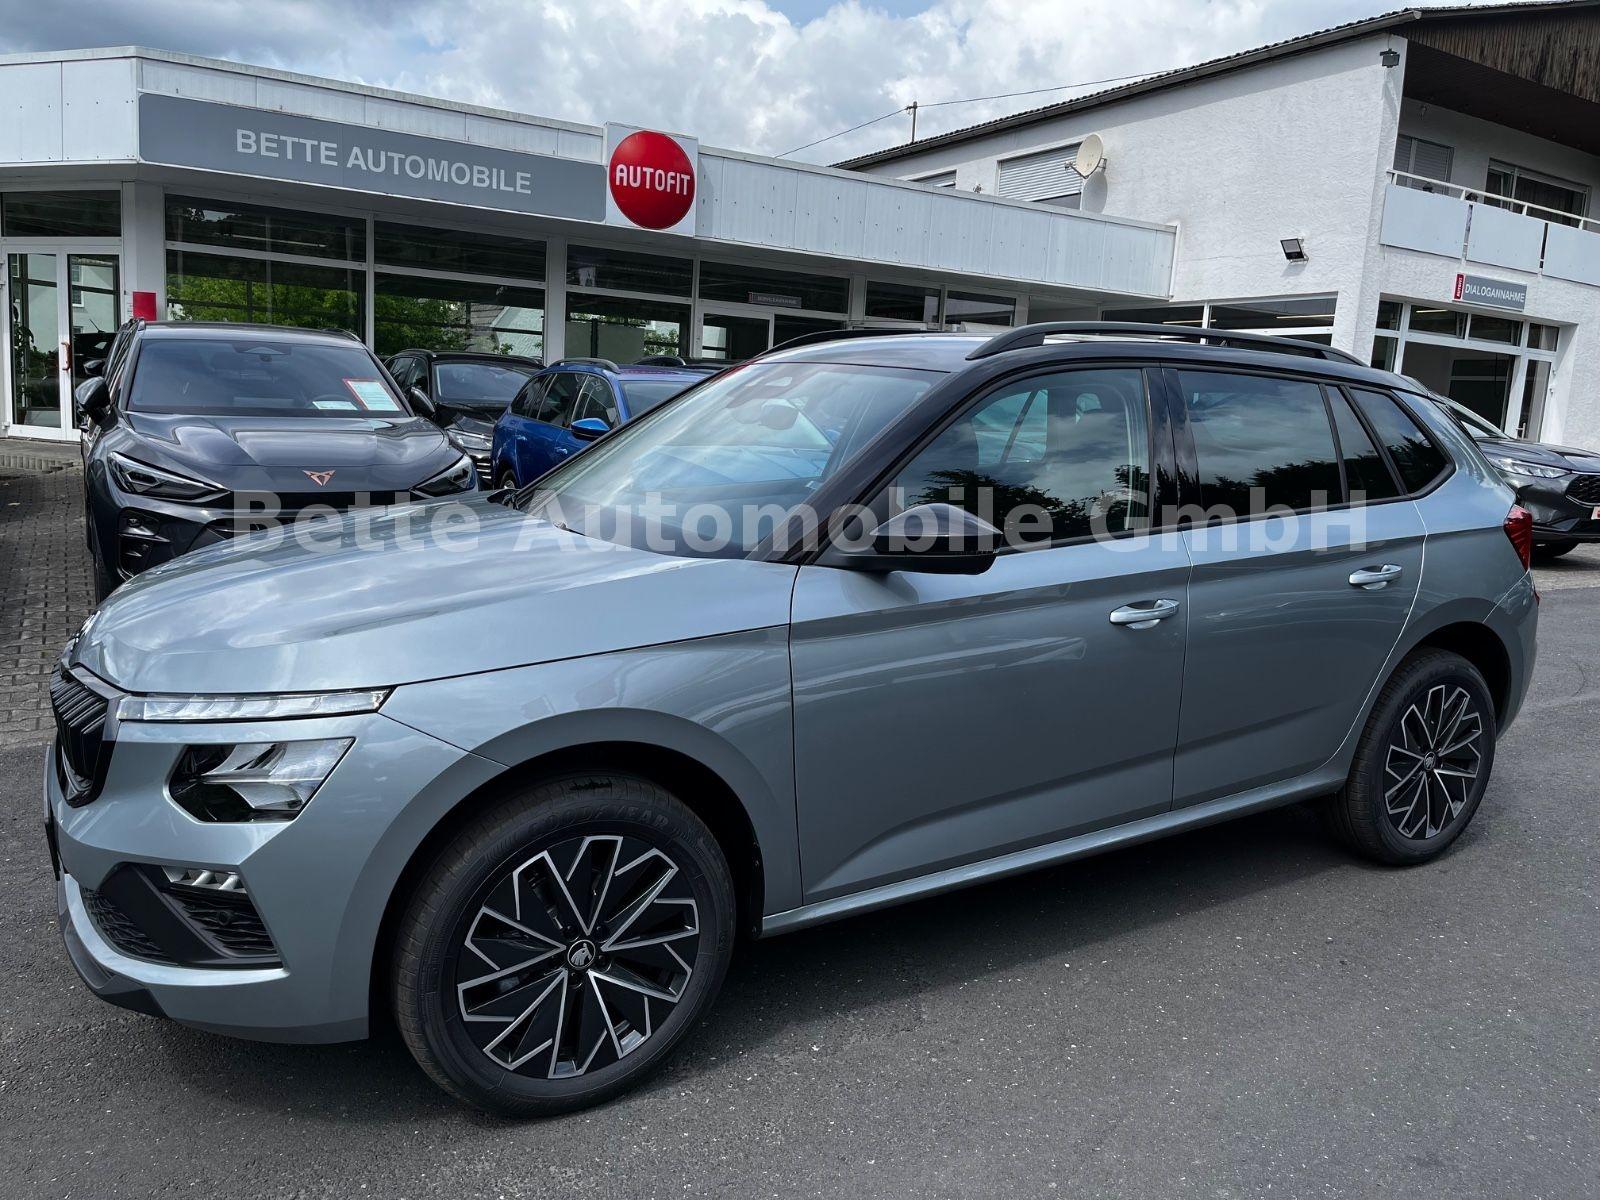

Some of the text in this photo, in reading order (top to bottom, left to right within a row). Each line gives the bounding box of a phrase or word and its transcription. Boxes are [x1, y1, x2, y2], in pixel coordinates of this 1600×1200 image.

[236, 128, 532, 195] BETTE AUTOMOBILE
[615, 163, 691, 195] AUTOFIT
[1465, 283, 1526, 303] DIALOGANNAHME
